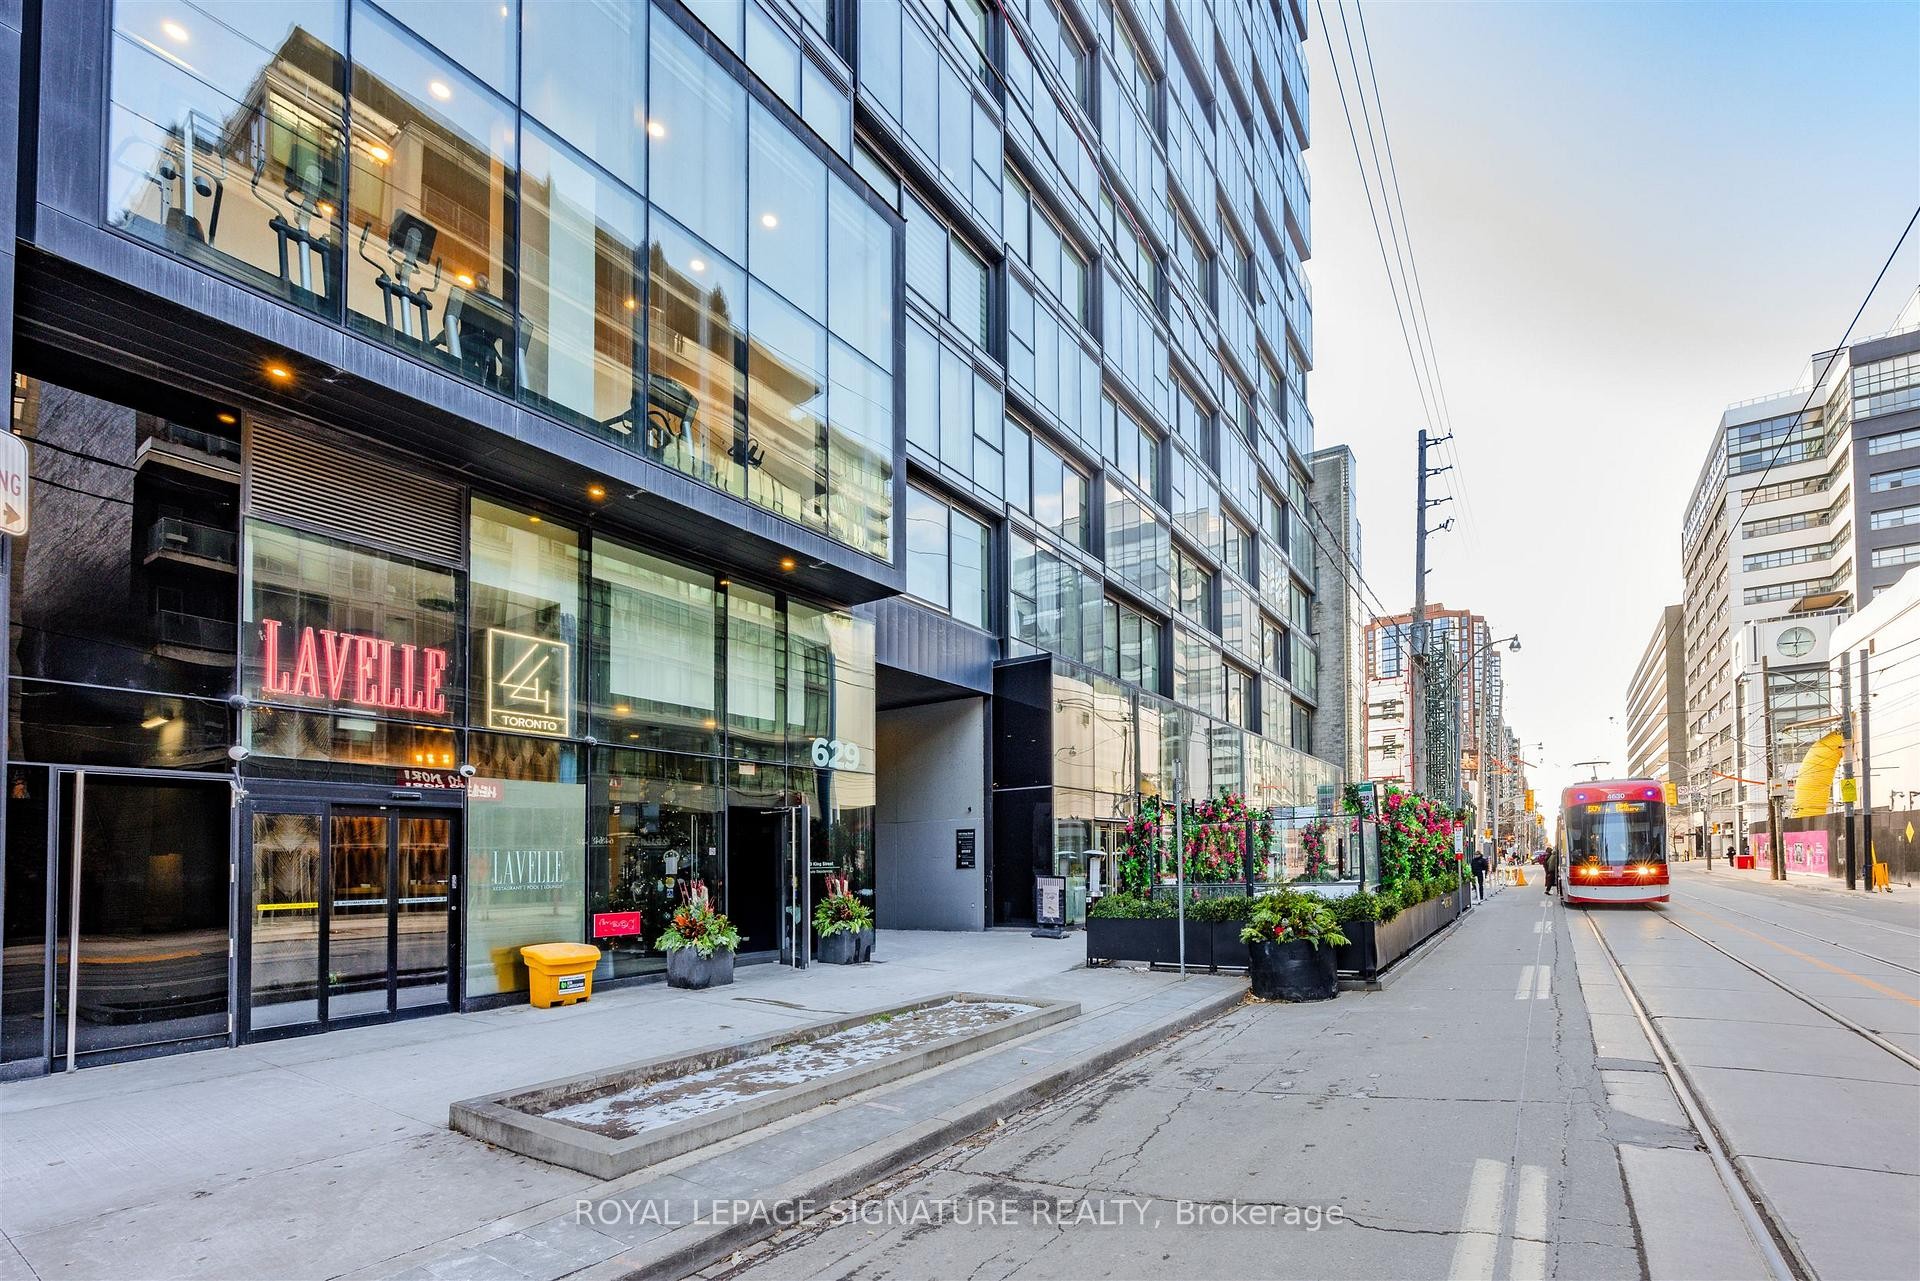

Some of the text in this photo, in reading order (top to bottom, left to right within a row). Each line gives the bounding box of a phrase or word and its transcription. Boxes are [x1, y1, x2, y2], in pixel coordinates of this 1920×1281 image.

[262, 618, 446, 714] LAVELLE
[501, 715, 557, 731] TORONTO
[811, 737, 860, 770] 629
[492, 851, 563, 884] LAVELLE
